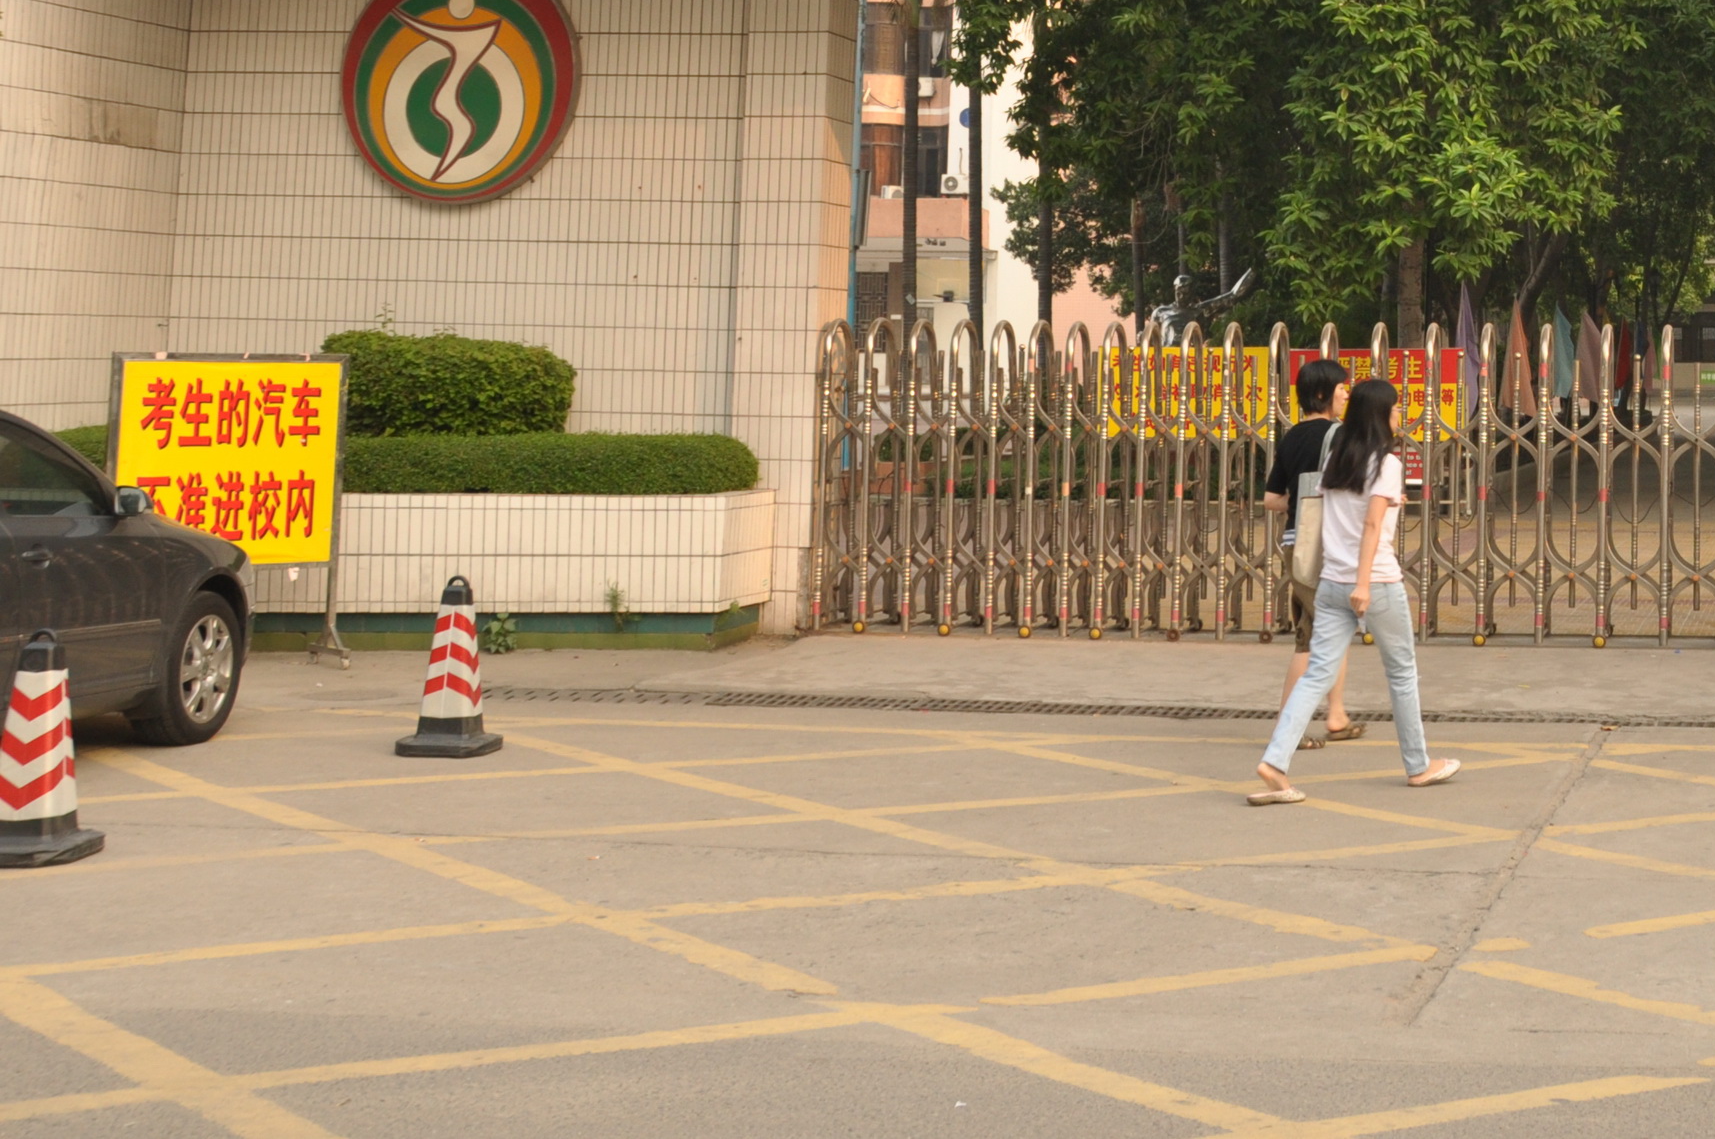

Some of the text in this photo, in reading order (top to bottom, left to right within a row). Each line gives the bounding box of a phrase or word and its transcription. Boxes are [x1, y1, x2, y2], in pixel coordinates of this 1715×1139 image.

[141, 377, 321, 450] 考生的汽车
[137, 470, 315, 541] 不准进校内
